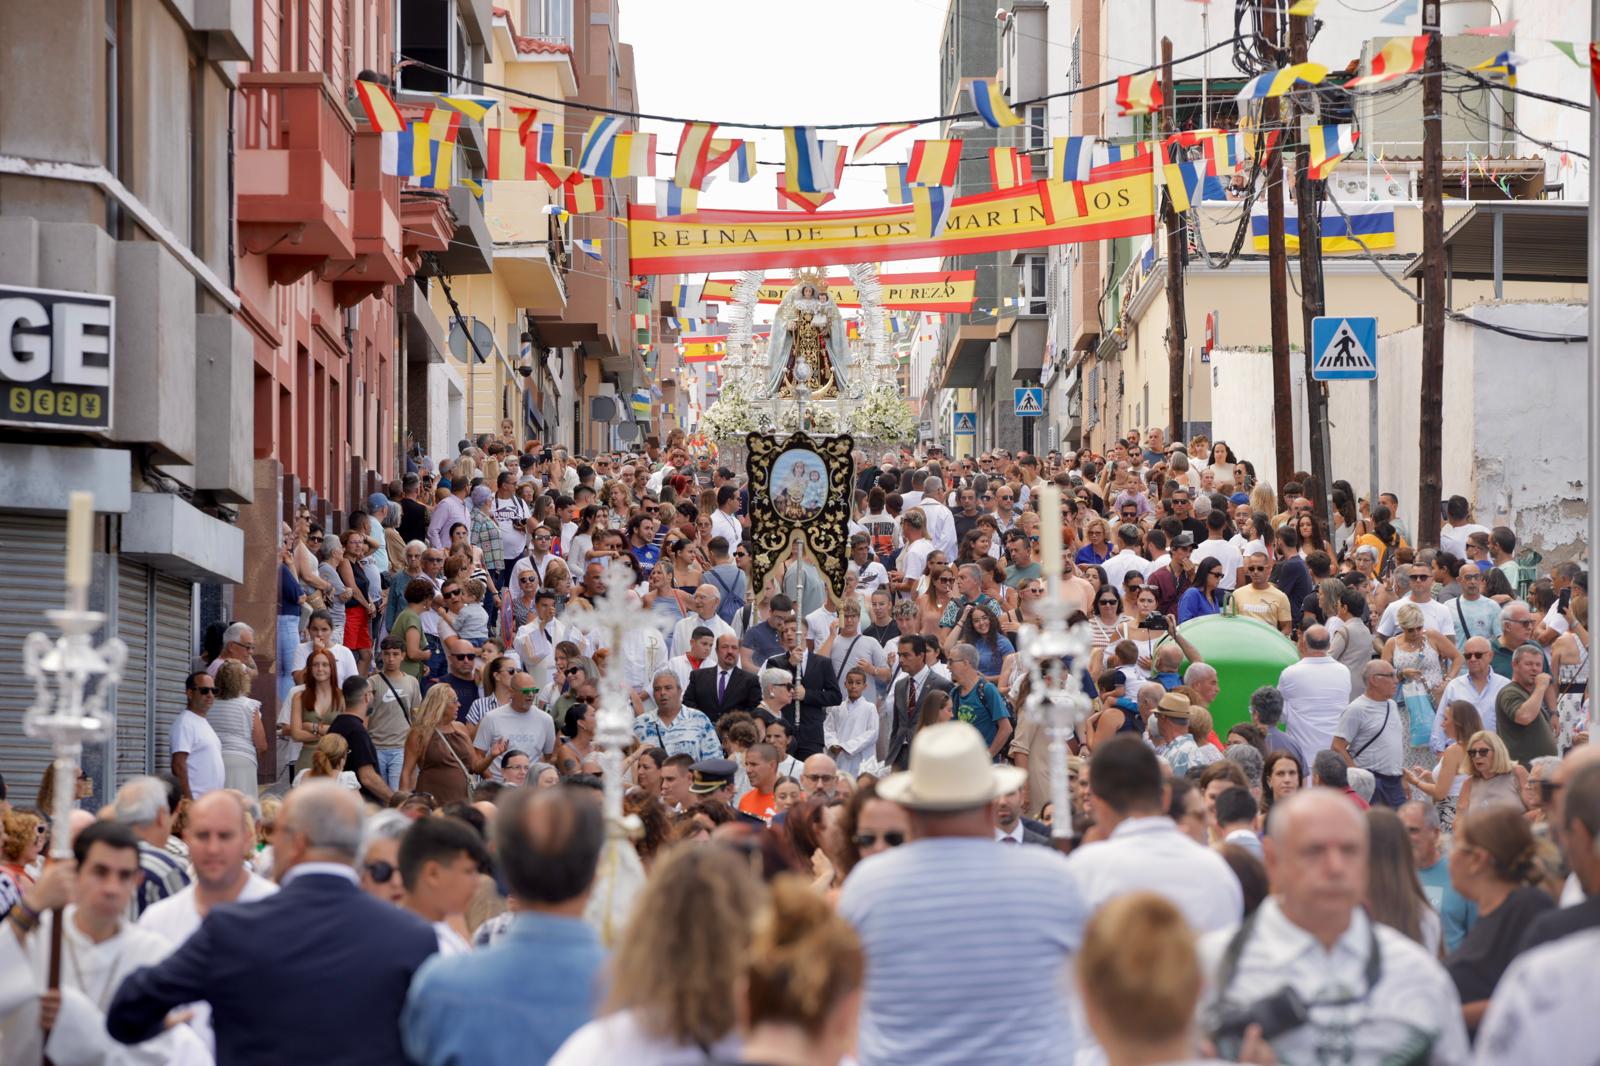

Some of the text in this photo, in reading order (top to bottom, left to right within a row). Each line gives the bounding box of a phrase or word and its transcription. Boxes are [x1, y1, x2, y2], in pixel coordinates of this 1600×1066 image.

[652, 188, 1131, 248] REINA DE LOS MARINOS
